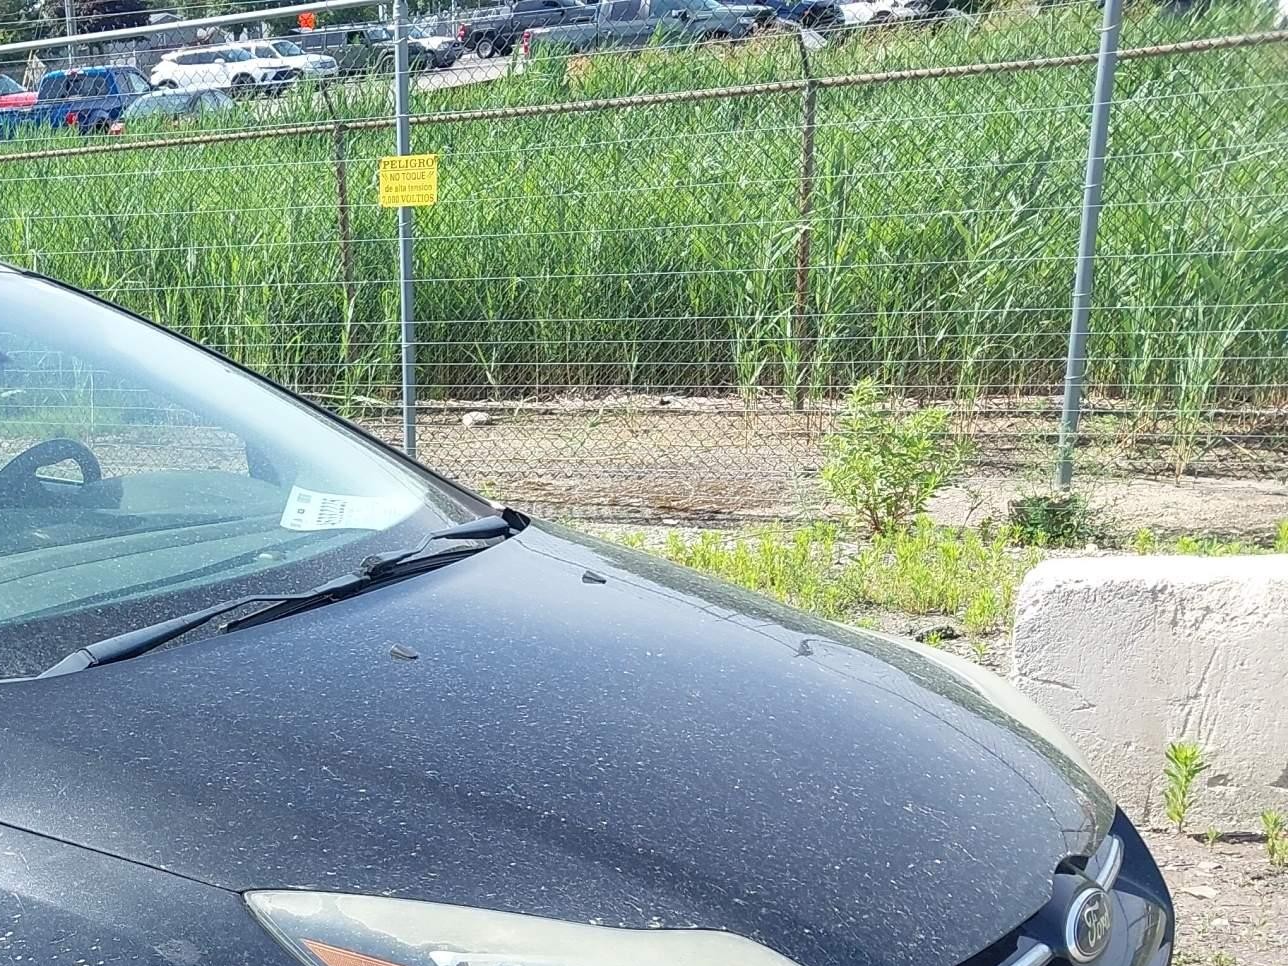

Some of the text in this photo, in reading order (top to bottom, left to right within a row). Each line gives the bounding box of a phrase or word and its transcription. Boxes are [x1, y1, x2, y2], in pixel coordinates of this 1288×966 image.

[382, 157, 434, 169] PELIGRO
[389, 171, 426, 181] NO TOQUE
[401, 193, 434, 203] VOLTIOS
[1084, 900, 1111, 948] Ford
